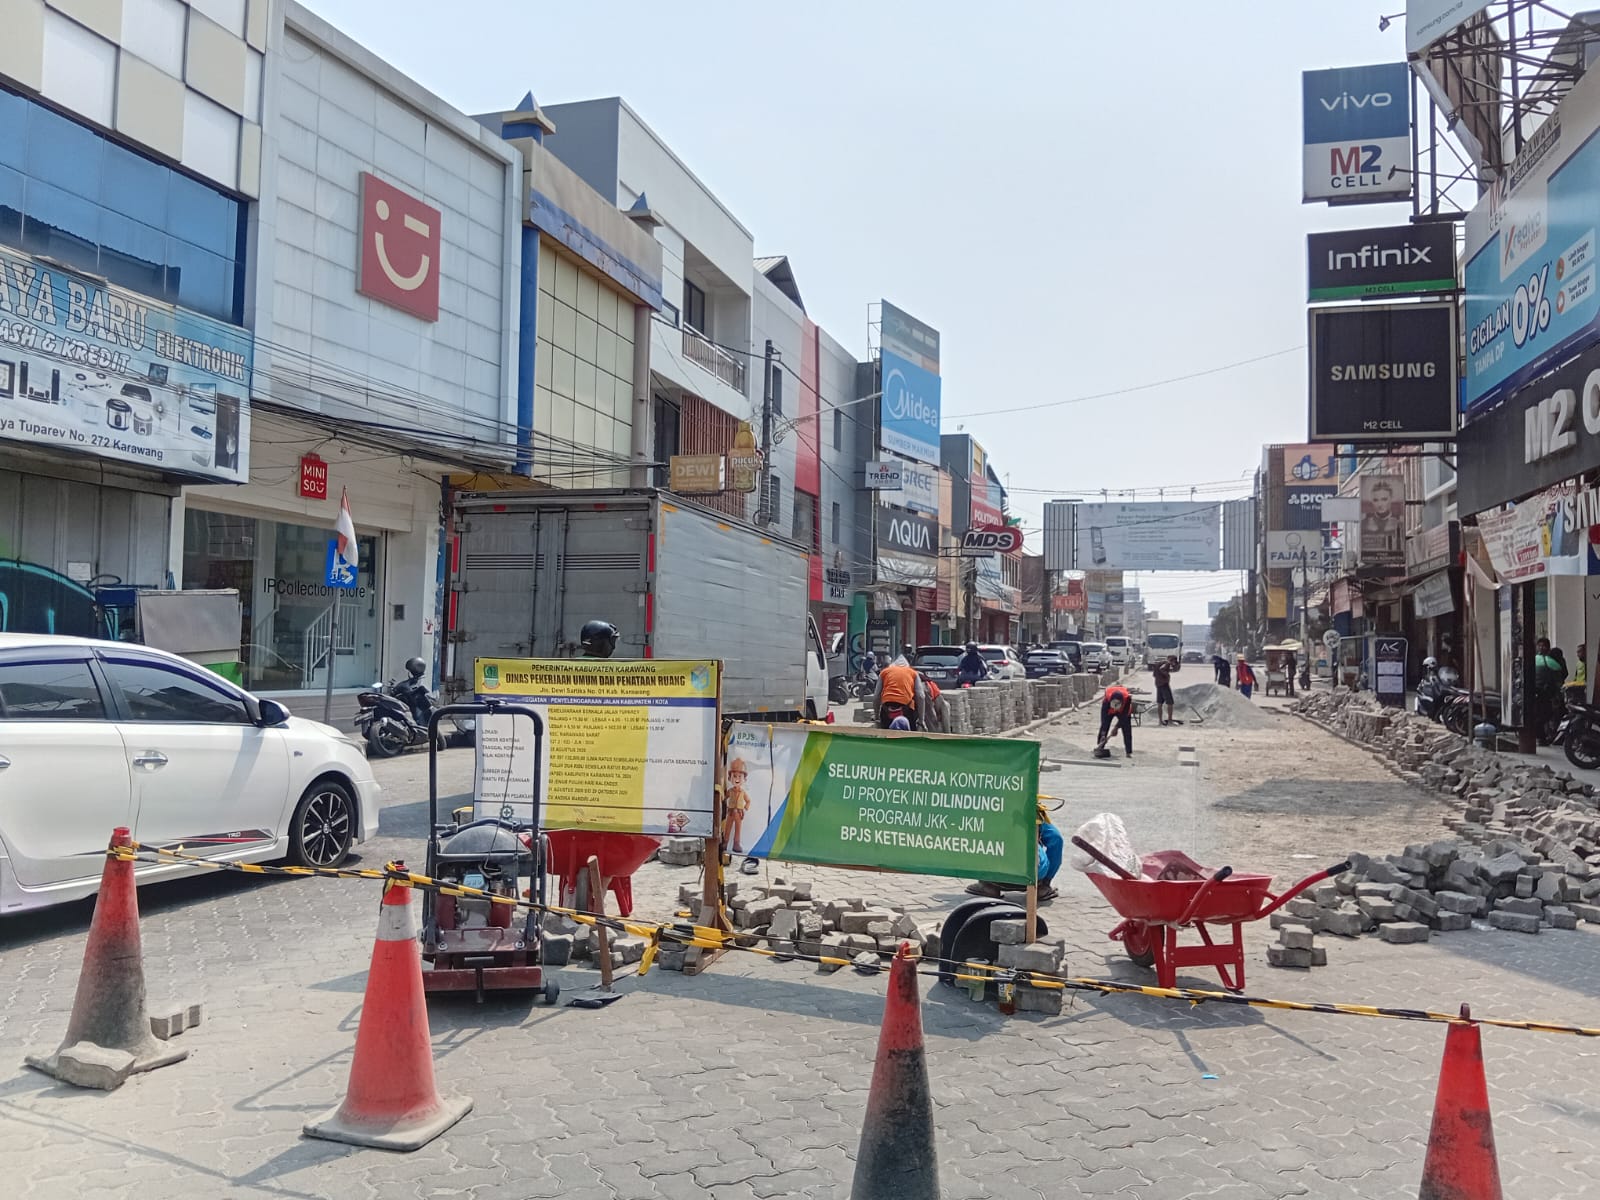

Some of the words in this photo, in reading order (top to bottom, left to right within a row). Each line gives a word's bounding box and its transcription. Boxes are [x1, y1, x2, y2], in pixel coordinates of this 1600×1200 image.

[1320, 92, 1392, 111] vivo
[1510, 112, 1560, 174] KARAWANG
[1331, 145, 1382, 175] M2
[1331, 174, 1381, 188] CELL
[1328, 242, 1432, 271] Infinix
[65, 279, 150, 351] BARU
[1470, 299, 1510, 355] CICILAN
[41, 332, 57, 353] &
[61, 337, 131, 374] KREDIT
[155, 329, 245, 381] ELEKTRONIK
[1331, 362, 1436, 381] SAMSUNG
[893, 387, 938, 428] Midea
[18, 419, 66, 439] Tuparev
[69, 429, 88, 443] No.
[91, 434, 110, 448] 272
[113, 439, 164, 460] Karawang
[1363, 421, 1378, 430] M2
[1379, 420, 1403, 430] CELL
[1525, 389, 1578, 465] M2
[303, 464, 326, 479] MINI
[675, 464, 715, 477] DEWI
[869, 472, 900, 480] TREND
[888, 518, 931, 550] AQUA
[964, 532, 1013, 548] MDS
[505, 673, 529, 684] DINAS
[573, 674, 598, 685] UMUM
[599, 675, 615, 686] DAN
[616, 675, 656, 687] PENATAAN
[658, 675, 686, 687] RUANG
[531, 664, 574, 673] PEMERINTAH
[574, 665, 614, 673] KABUPATEN
[615, 665, 656, 674] KARAWANG
[828, 763, 886, 782] SELURUH
[889, 768, 947, 787] PEKERJA
[949, 772, 1024, 792] KONTRUKSI
[843, 785, 855, 800] DI
[858, 786, 909, 805] PROYEK
[912, 791, 928, 806] INI
[931, 792, 1004, 812] DILINDUNGI
[858, 807, 922, 828] PROGRAM
[924, 814, 948, 830] JKK
[958, 816, 985, 833] JKM
[841, 825, 872, 844] BPJS
[874, 829, 1005, 857] KETENAGAKERJAAN
